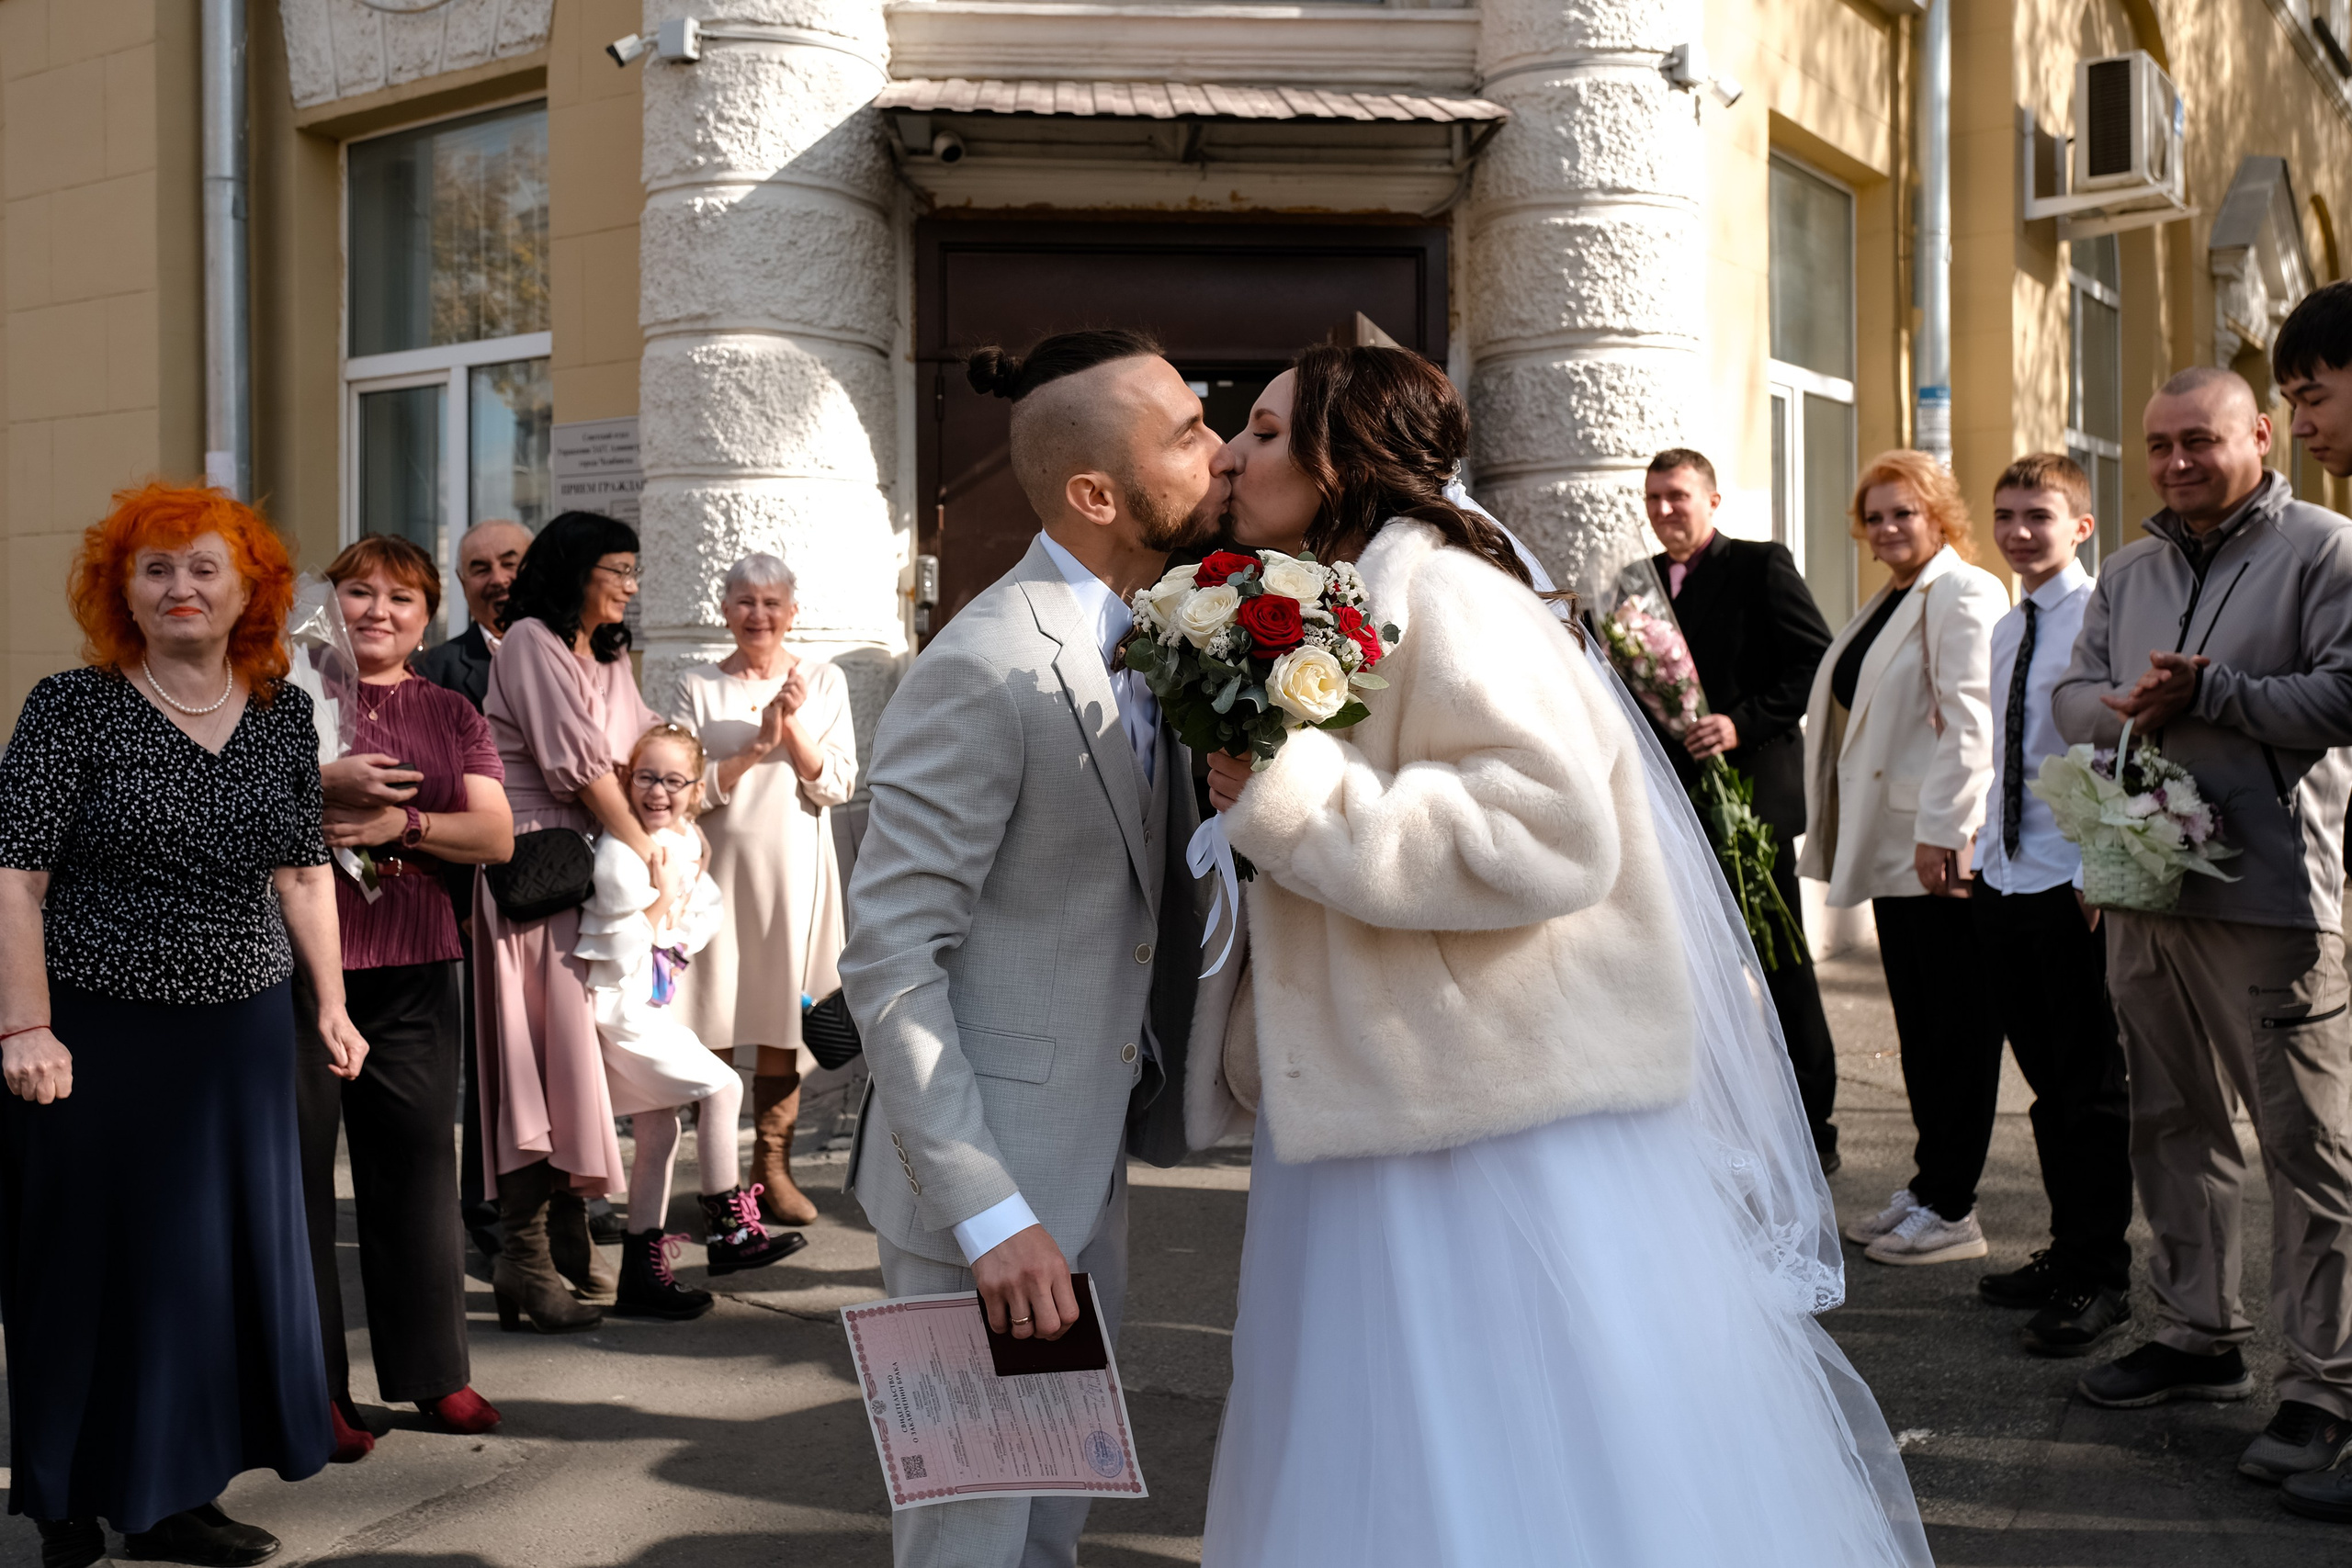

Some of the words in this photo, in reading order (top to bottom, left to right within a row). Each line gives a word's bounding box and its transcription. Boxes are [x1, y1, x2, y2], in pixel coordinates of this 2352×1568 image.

[891, 1361, 902, 1384] БРАКА
[887, 1374, 908, 1432] СВИДЕТЕЛЬСТВО
[899, 1386, 916, 1435] ЗАКЛЮЧЕНИИ
